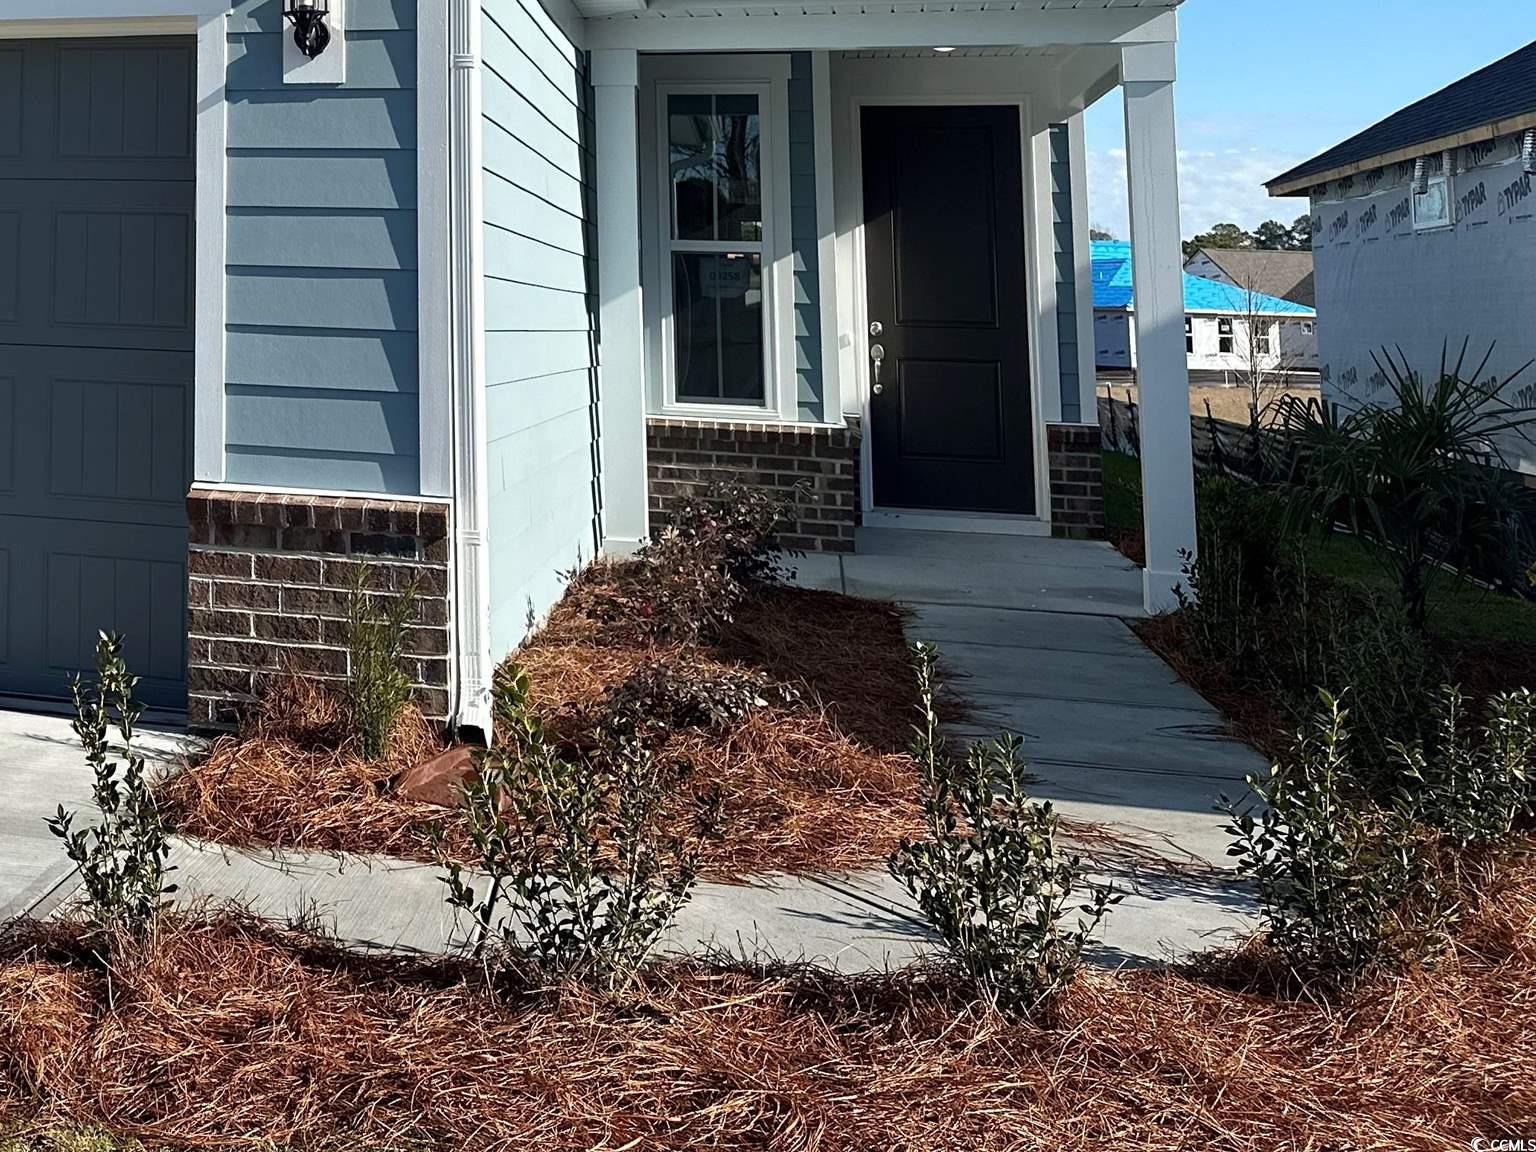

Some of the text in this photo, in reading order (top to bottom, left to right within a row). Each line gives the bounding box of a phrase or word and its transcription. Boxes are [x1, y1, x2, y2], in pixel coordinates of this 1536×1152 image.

[1461, 181, 1487, 217] TYPAR
[1504, 174, 1532, 209] TYPAR
[1359, 203, 1378, 234] TYPAR
[1389, 197, 1410, 228] TYPAR
